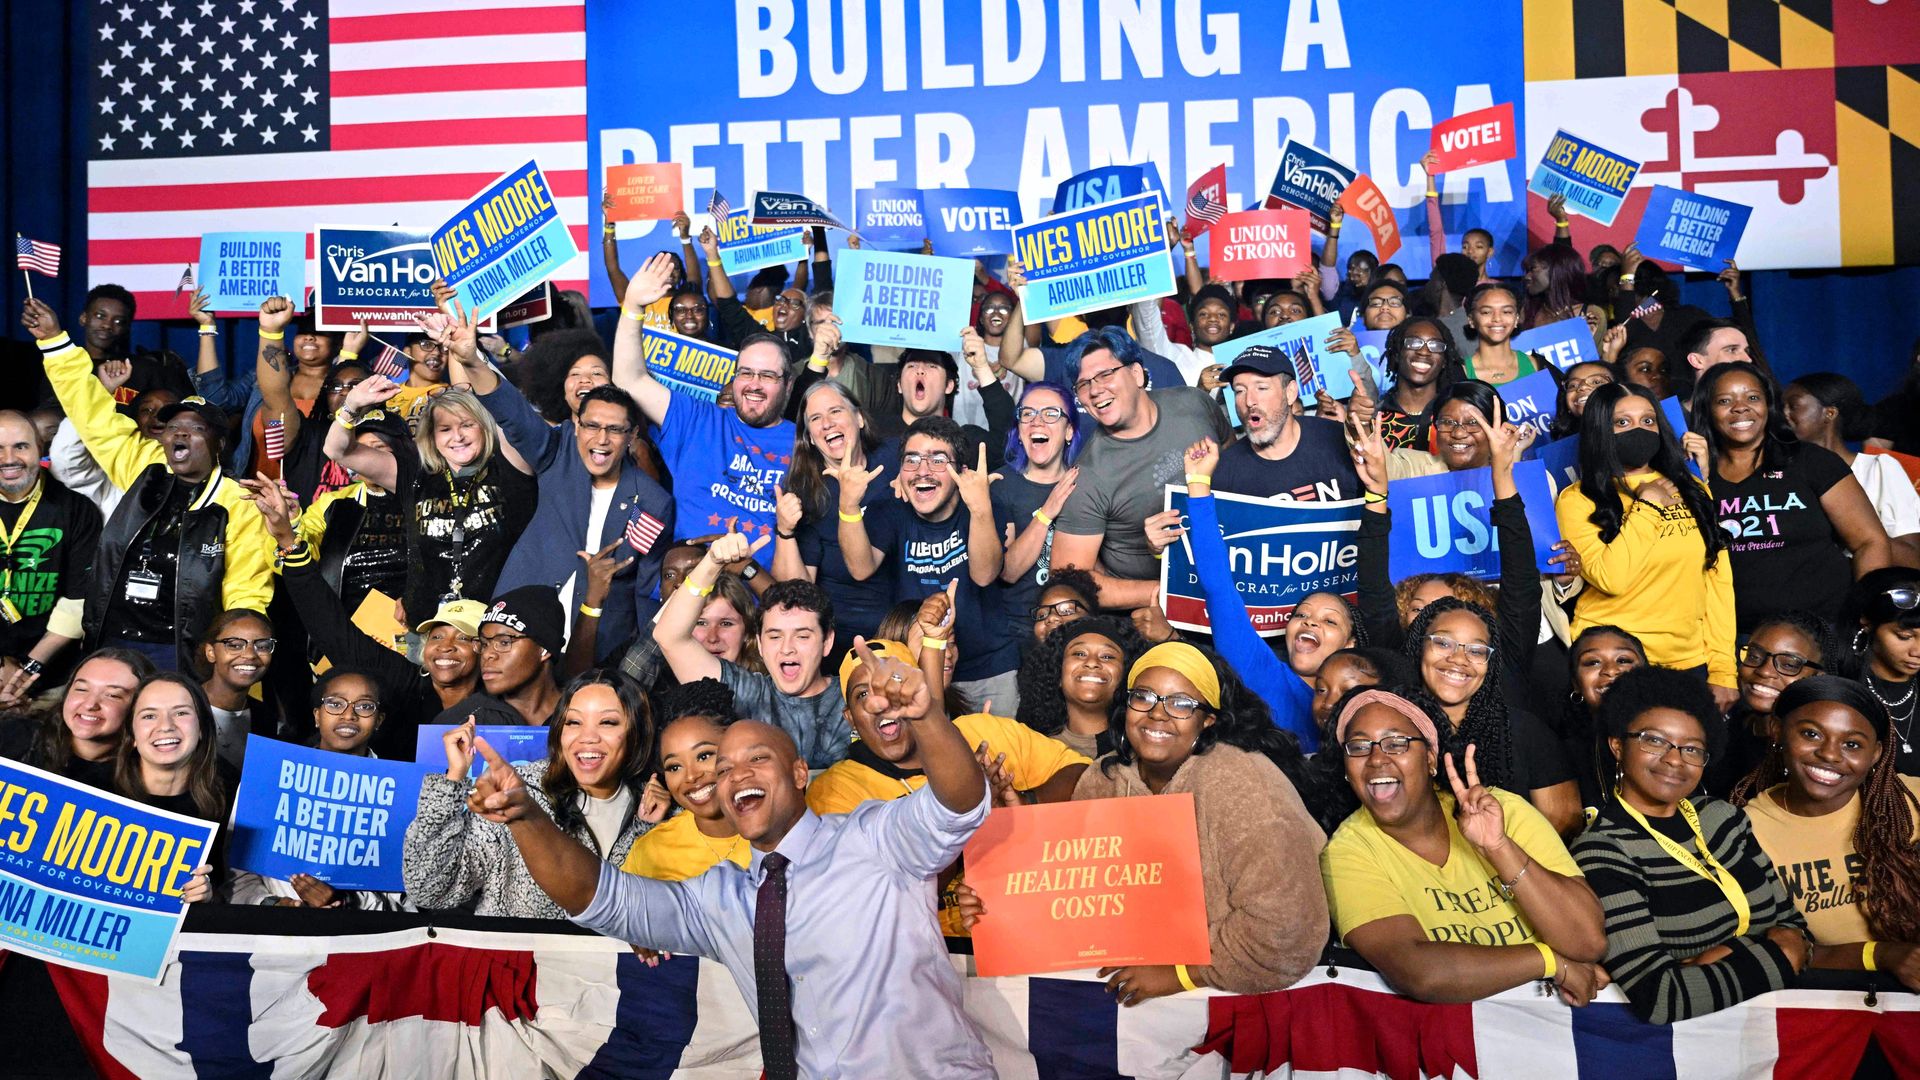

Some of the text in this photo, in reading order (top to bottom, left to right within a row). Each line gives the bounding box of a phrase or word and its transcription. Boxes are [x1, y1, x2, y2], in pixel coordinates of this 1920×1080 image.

[735, 0, 1351, 98] BUILDING A
[1440, 121, 1501, 153] VOTE!
[600, 84, 1513, 239] BETTER AMERICA
[1286, 152, 1306, 168] Chris
[1546, 135, 1637, 192] WES MOORE
[616, 186, 646, 196] HEALTH
[628, 176, 655, 186] LOWER
[1065, 175, 1122, 211] USA
[1284, 161, 1341, 204] Van Holle
[630, 195, 656, 205] COSTS
[760, 200, 802, 211] Van
[872, 199, 917, 213] UNION
[1566, 183, 1603, 210] MILLER
[434, 169, 551, 278] WES MOORE
[866, 213, 923, 227] STRONG
[941, 207, 1011, 232] VOTE!
[1356, 188, 1394, 246] USA
[1670, 198, 1730, 226] BUILDING
[717, 214, 749, 243] WES
[1018, 204, 1162, 271] WES MOORE
[1230, 224, 1288, 243] UNION
[1664, 215, 1723, 242] A BETTER
[220, 241, 282, 258] BUILDING
[326, 244, 365, 258] Chris
[451, 215, 544, 281] DEMOCRAT FOR GOVERNOR
[734, 240, 792, 264] ARUNA MILLER
[1223, 242, 1296, 261] STRONG
[1659, 231, 1716, 258] AMERICA
[218, 260, 280, 277] A BETTER
[327, 256, 437, 284] Van Ho
[467, 262, 510, 306] ARUNA
[504, 235, 552, 281] MILLER
[864, 262, 943, 288] BUILDING
[1035, 246, 1150, 277] DEMOCRAT FOR GOVERNOR
[219, 279, 279, 296] AMERICA
[338, 287, 405, 297] DEMOCRAT
[406, 289, 420, 299] for
[863, 285, 940, 310] A BETTER
[1048, 275, 1095, 306] ARUNA
[1096, 263, 1147, 295] MILLER
[862, 307, 936, 332] AMERICA
[1537, 338, 1583, 368] TE!
[729, 454, 785, 484] BALET
[710, 482, 777, 513] PRESIDEN
[738, 474, 765, 497] FOR
[1411, 490, 1500, 559] US
[1260, 540, 1359, 577] Holle
[1731, 540, 1785, 552] Vice President
[28, 557, 35, 567] 3
[1188, 573, 1279, 597] DCRAT
[1276, 583, 1298, 597] for
[1301, 580, 1319, 592] US
[482, 608, 527, 632] ullets
[279, 760, 396, 806] BUILDING
[274, 792, 389, 837] A BETTER
[42, 801, 202, 898] MOORE
[271, 825, 381, 867] AMERICA
[1041, 836, 1123, 863] LOWER
[0, 852, 156, 905] CRAT FOR GOVERNOR
[1005, 862, 1163, 895] HEALTH CARE
[1778, 858, 1835, 899] WIE
[1051, 893, 1126, 920] COSTS
[35, 895, 132, 952] MILLER
[53, 940, 117, 960] GOVERNOR
